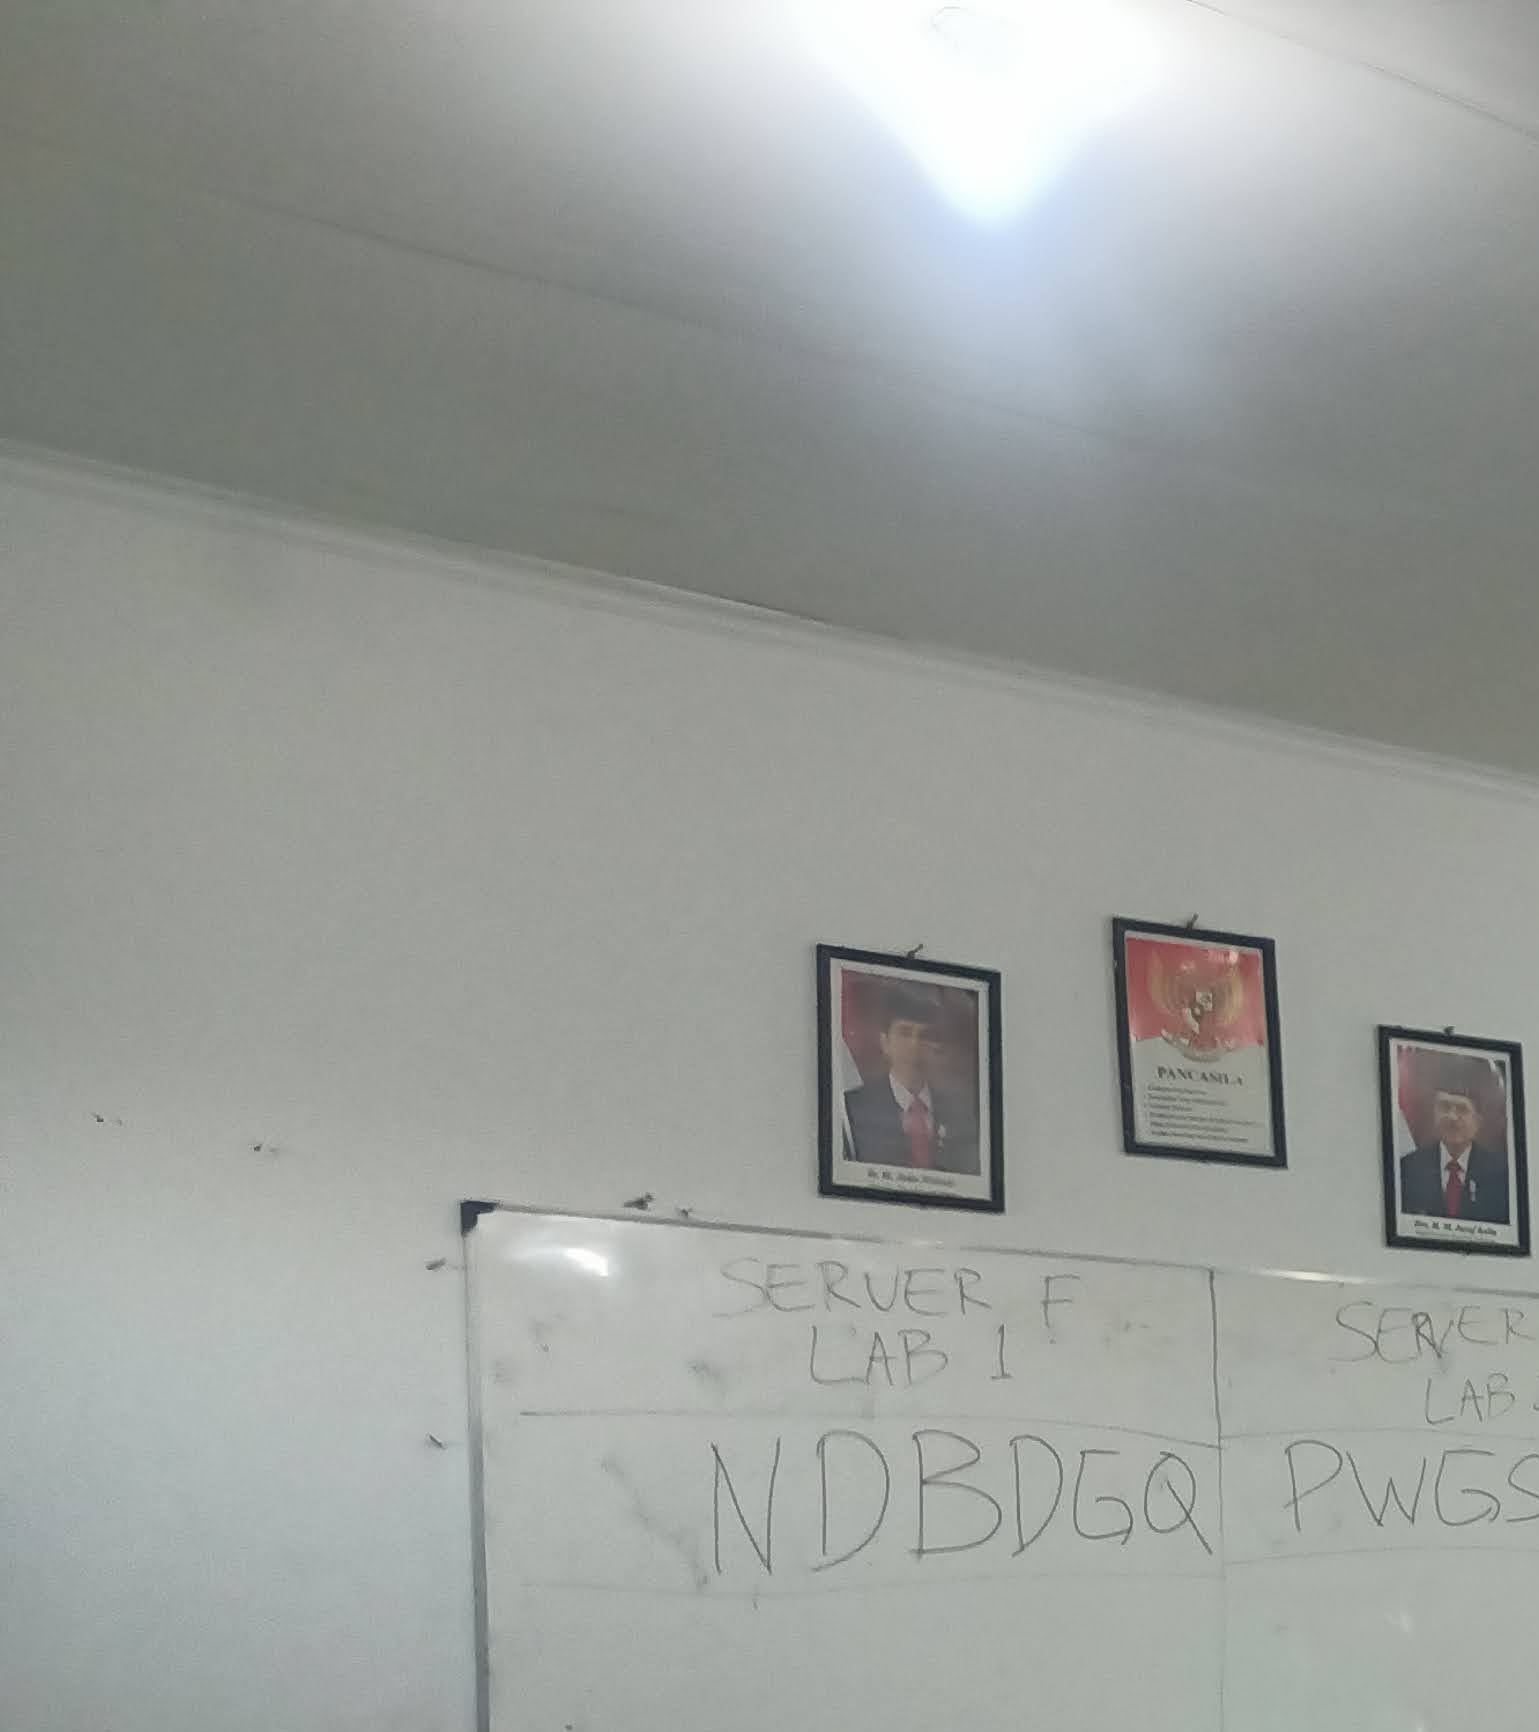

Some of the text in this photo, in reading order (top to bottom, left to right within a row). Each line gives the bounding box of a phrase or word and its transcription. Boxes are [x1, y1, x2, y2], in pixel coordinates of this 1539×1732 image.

[713, 1257, 1081, 1328] SERVER F
[809, 1325, 950, 1387] LAB
[1424, 1372, 1516, 1425] LAB
